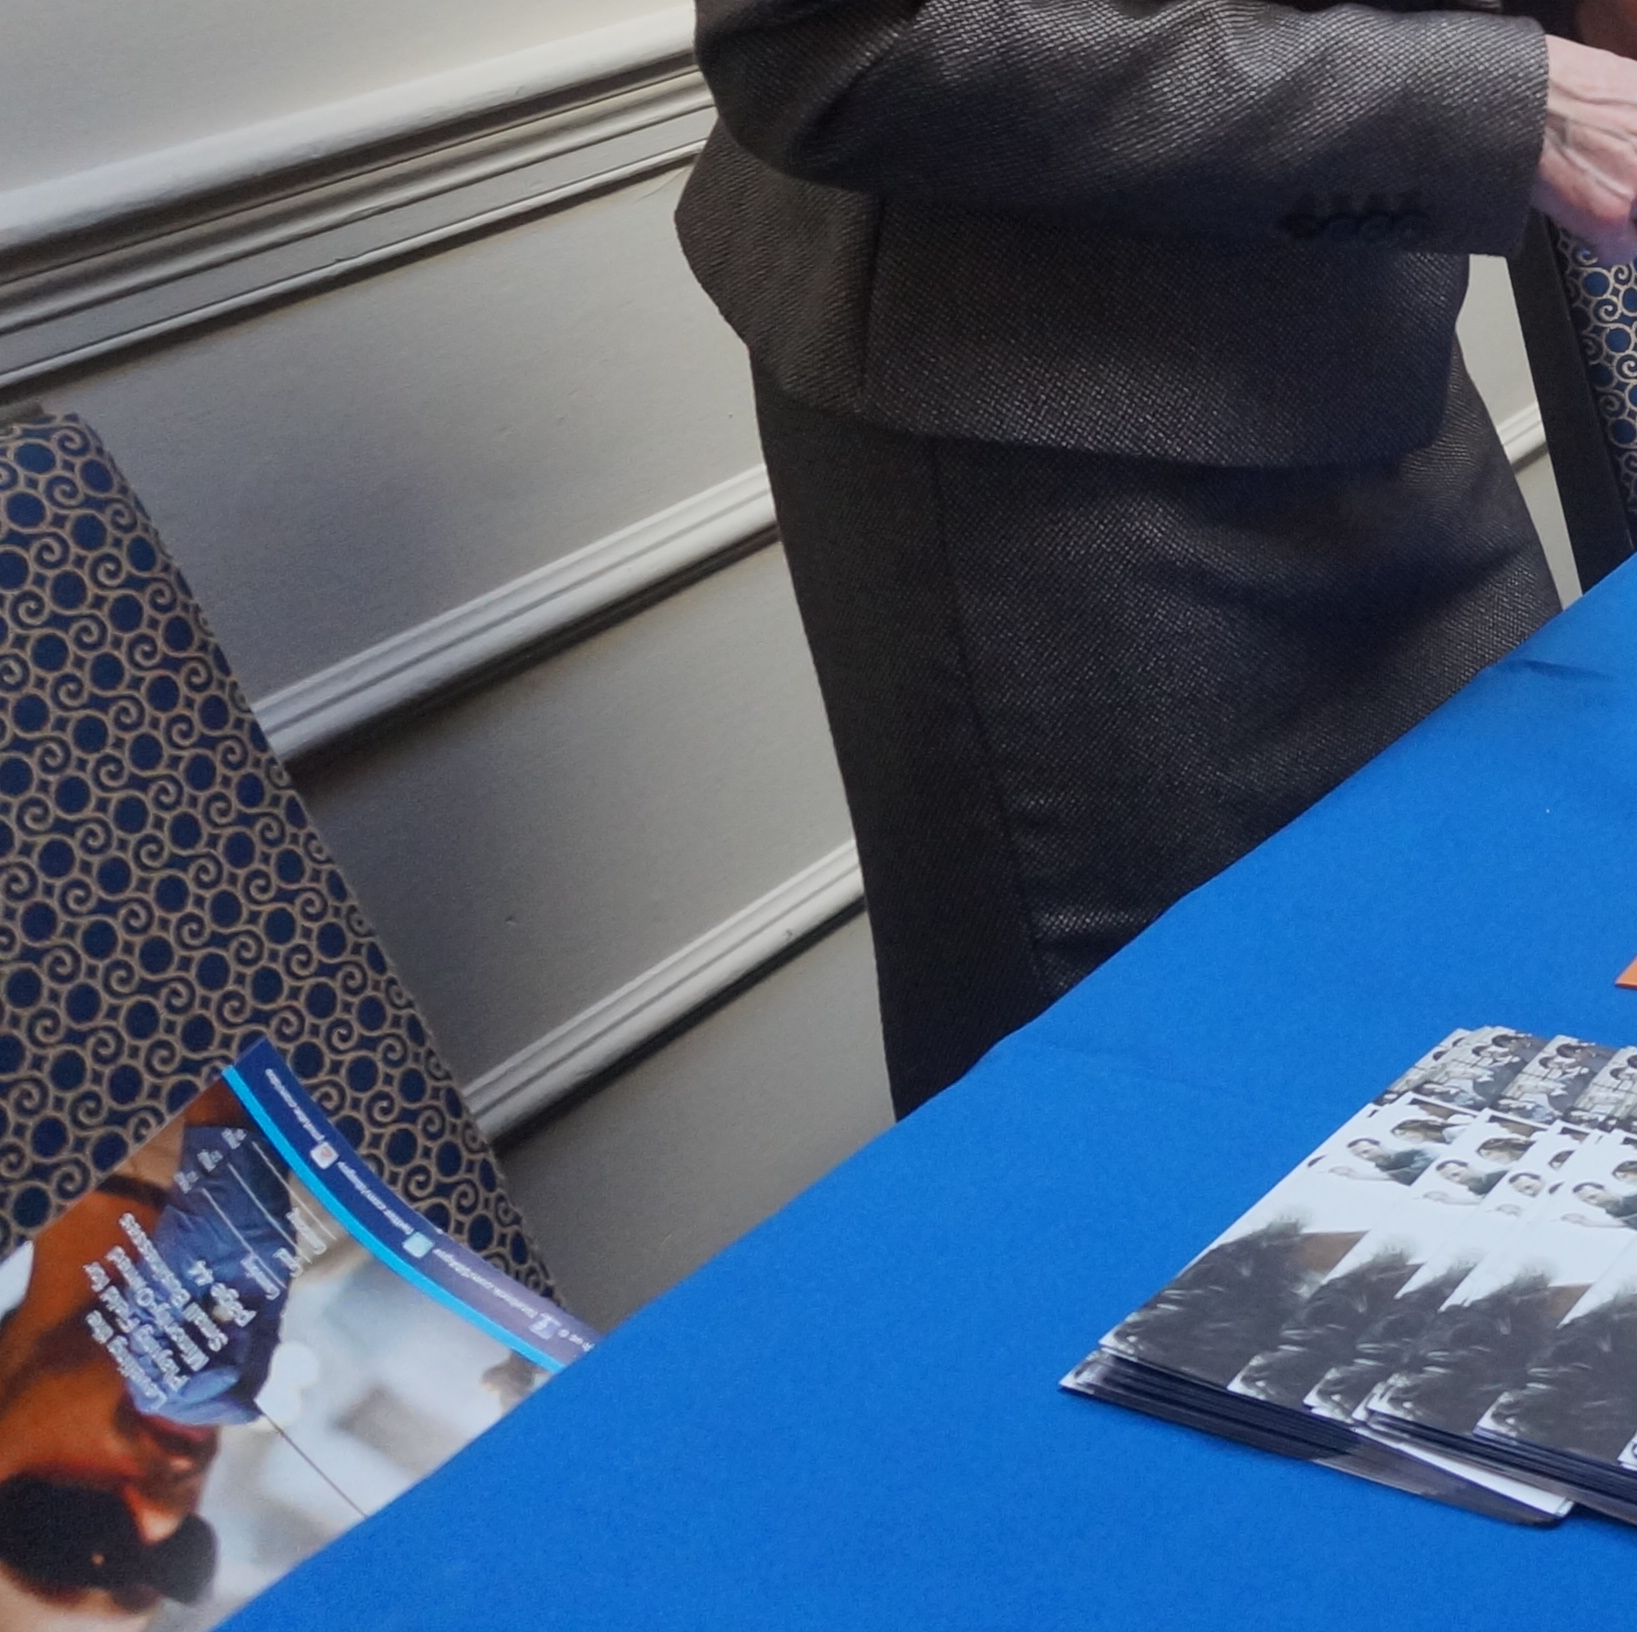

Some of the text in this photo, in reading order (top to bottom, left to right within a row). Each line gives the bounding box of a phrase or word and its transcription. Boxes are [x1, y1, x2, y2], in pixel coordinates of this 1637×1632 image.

[118, 1212, 192, 1308] Businesses
[86, 1310, 116, 1345] the
[100, 1285, 141, 1333] Field
[105, 1245, 210, 1372] Minority-Owned
[181, 1301, 229, 1352] Small
[210, 1282, 258, 1328] page
[128, 1323, 191, 1392] Playing
